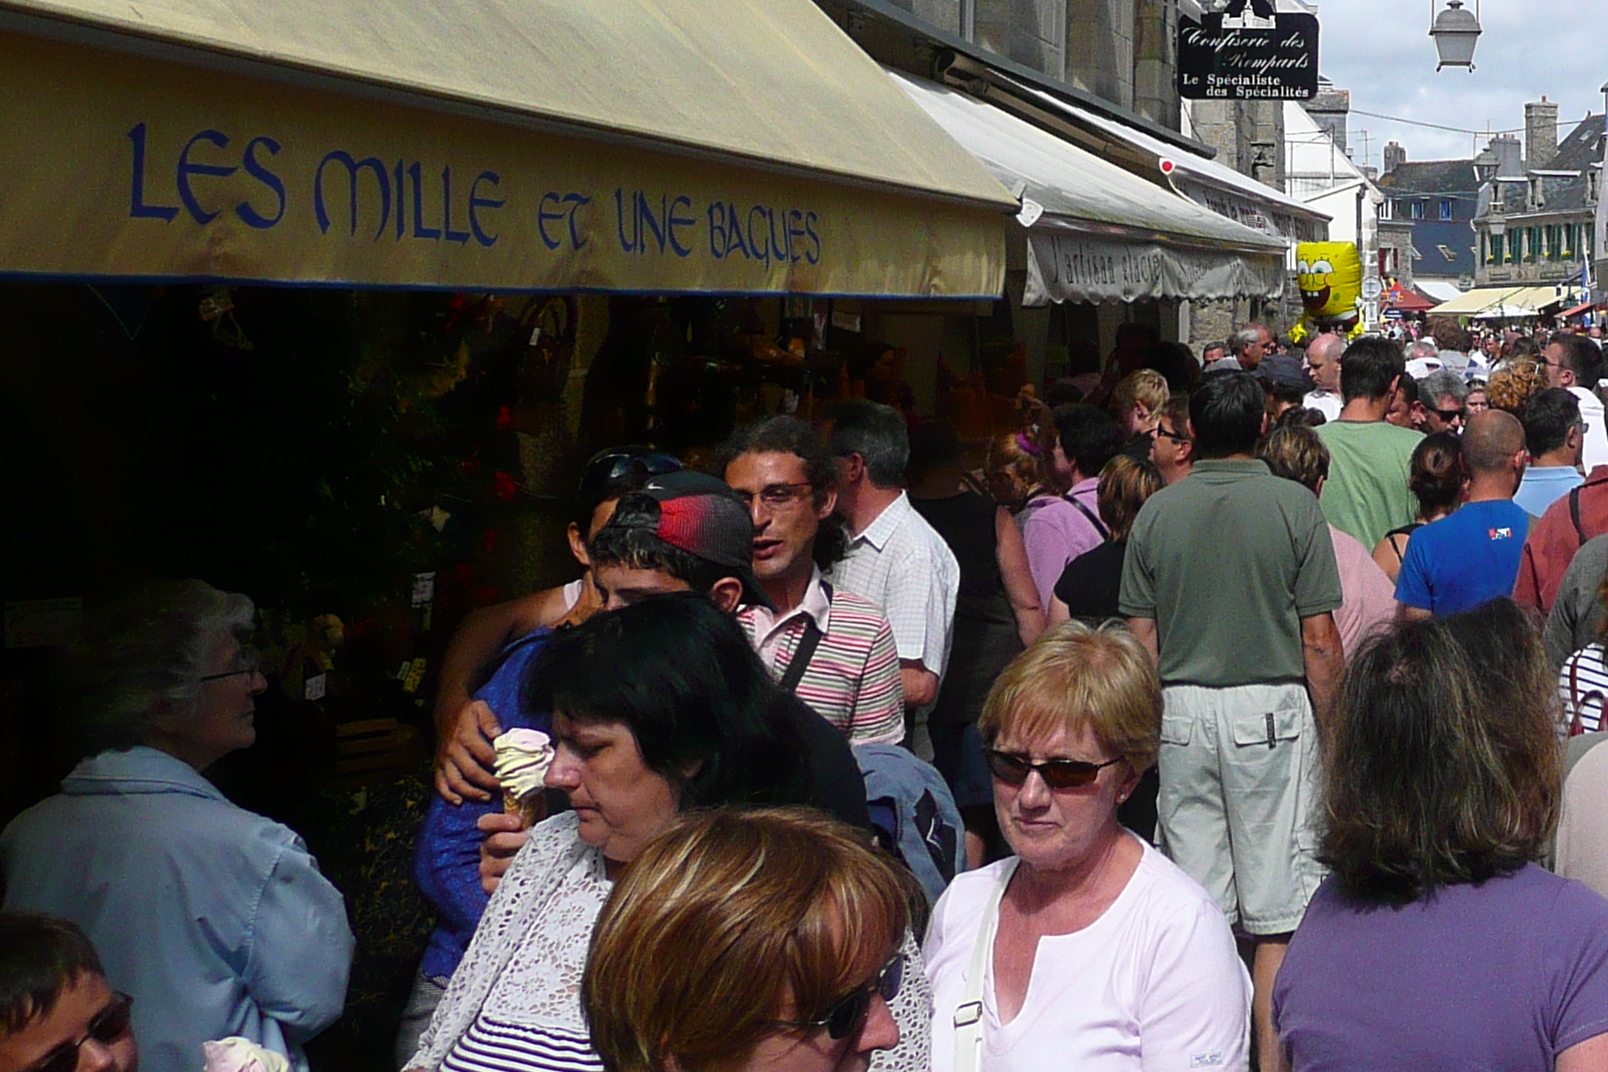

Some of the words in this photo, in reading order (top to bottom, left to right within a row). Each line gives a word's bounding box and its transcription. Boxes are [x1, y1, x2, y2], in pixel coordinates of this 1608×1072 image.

[1180, 26, 1271, 53] Confiserie
[1279, 31, 1306, 49] des
[1224, 52, 1309, 75] Remparts
[1183, 73, 1199, 86] Le
[1206, 73, 1281, 87] Spécialiste
[1205, 85, 1228, 97] des
[1236, 85, 1309, 99] Spécialités
[127, 122, 287, 230] LES
[314, 149, 508, 248] MILLE
[537, 190, 592, 252] ET
[615, 187, 697, 258] UNE
[707, 201, 821, 274] BAGUES
